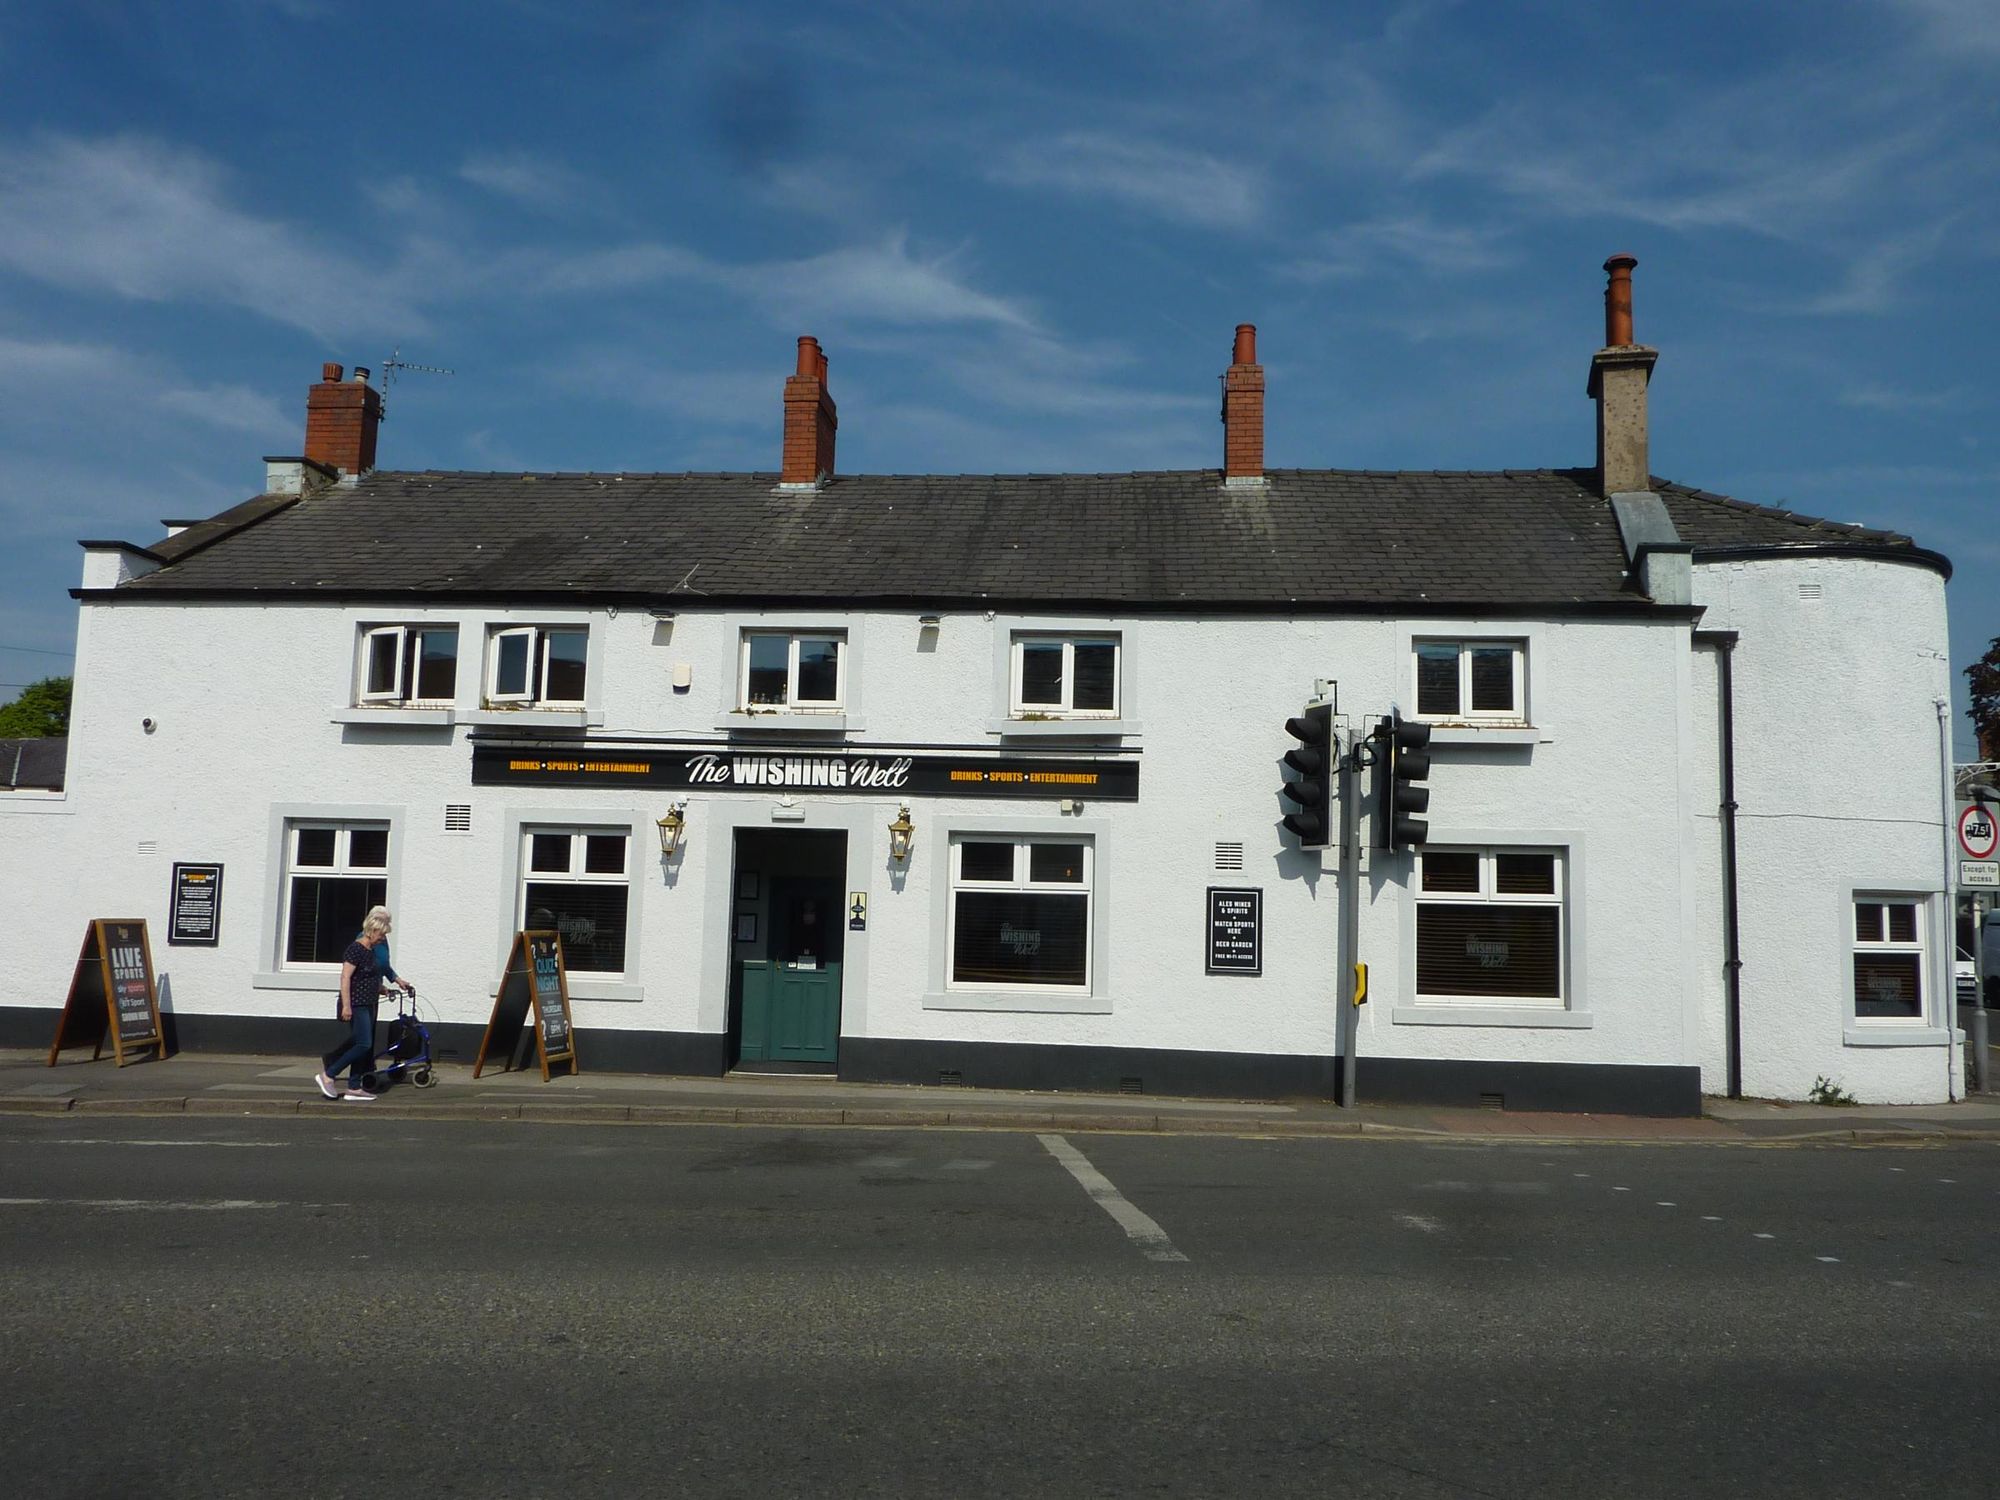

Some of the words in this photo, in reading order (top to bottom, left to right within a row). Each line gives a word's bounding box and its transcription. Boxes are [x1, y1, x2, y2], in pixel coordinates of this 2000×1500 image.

[510, 760, 541, 771] DRINKS
[546, 761, 579, 771] SPORTS
[584, 762, 650, 773] ENTERTAINMENT
[685, 754, 730, 784] The
[732, 757, 847, 787] WISHING
[850, 757, 913, 787] Well
[950, 770, 983, 781] DRINKS
[989, 771, 1023, 782] SPORTS
[1029, 772, 1098, 784] ENTERTAINMENT
[1963, 865, 1985, 873] Except
[1000, 930, 1041, 943] WISHING
[111, 947, 143, 968] LIVE
[536, 958, 556, 974] QUIZ
[114, 968, 145, 980] SPORTS
[536, 975, 559, 992] NIGHT
[131, 997, 146, 1008] Sport
